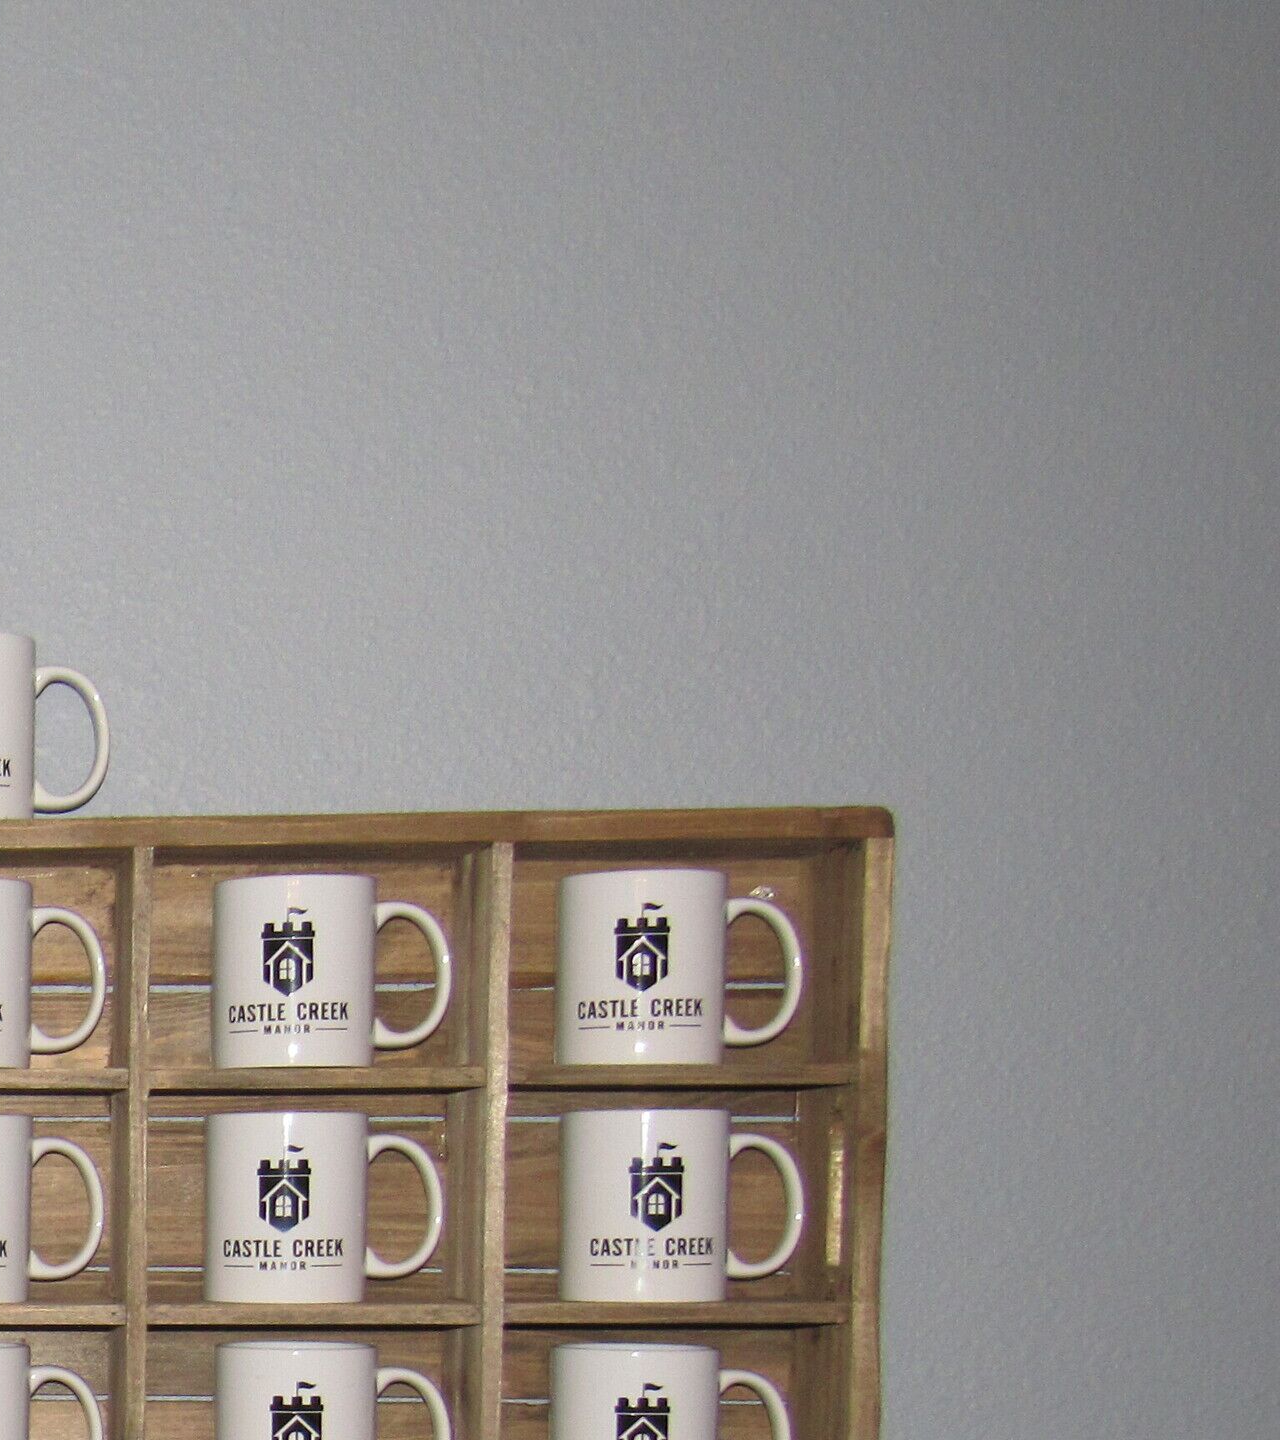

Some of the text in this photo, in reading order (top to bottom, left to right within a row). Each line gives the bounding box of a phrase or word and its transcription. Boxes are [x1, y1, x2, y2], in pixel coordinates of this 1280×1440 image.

[228, 1002, 349, 1023] CASTLE CREEK
[577, 998, 703, 1019] CASTLE CREEK
[263, 1024, 311, 1035] MANOR
[615, 1021, 665, 1031] MANOR
[223, 1238, 344, 1258] CASTLE CREEK
[665, 1236, 714, 1256] CREEK
[259, 1261, 307, 1271] MANOR
